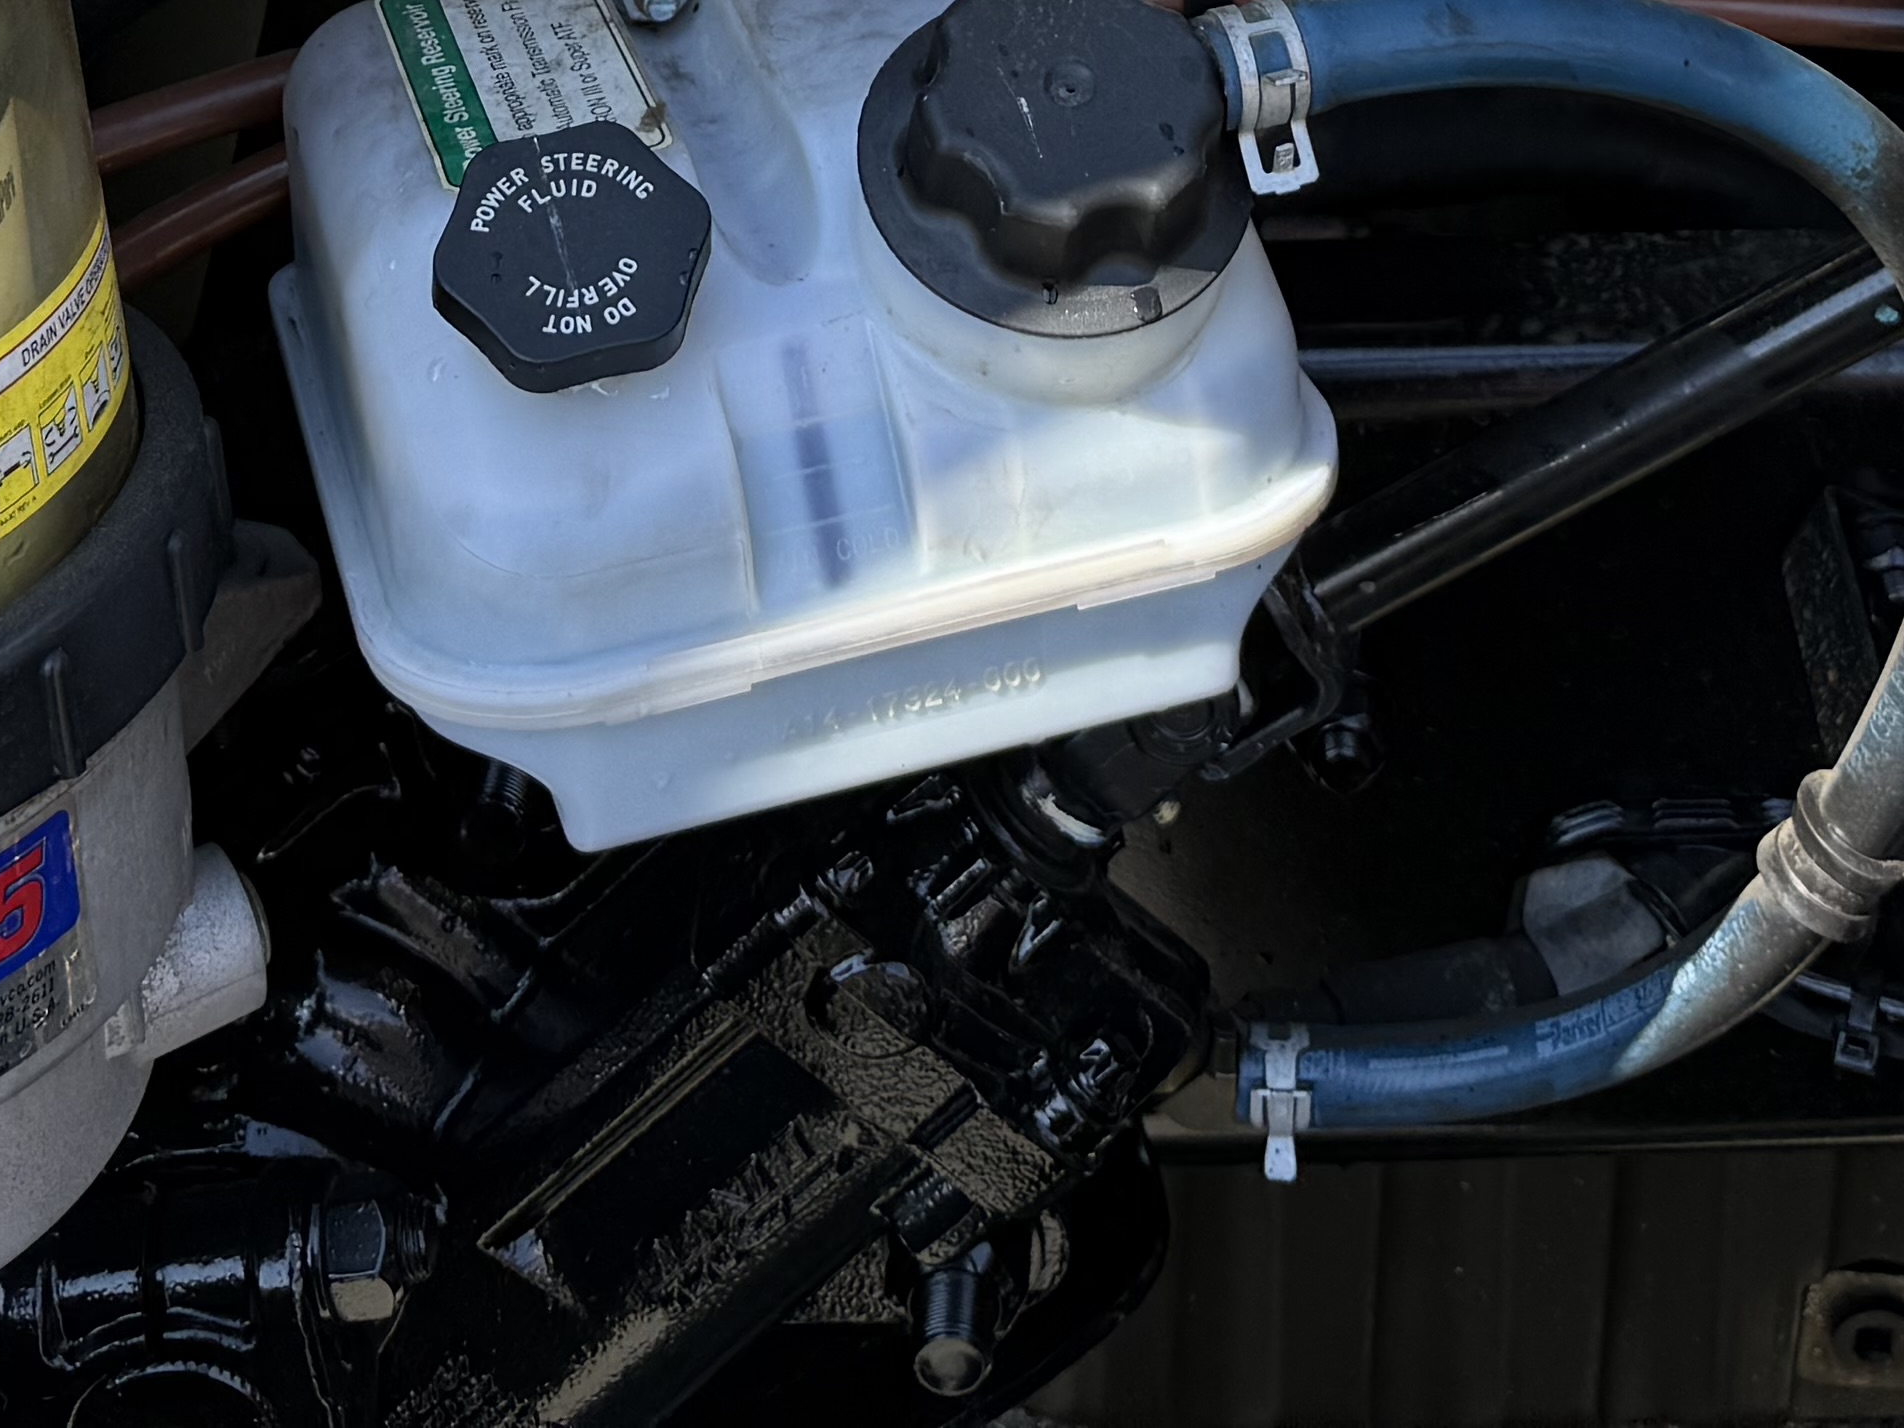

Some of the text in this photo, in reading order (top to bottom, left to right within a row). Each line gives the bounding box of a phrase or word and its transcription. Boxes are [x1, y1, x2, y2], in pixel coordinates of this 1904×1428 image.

[406, 3, 444, 66] Reservoir
[480, 30, 495, 45] on
[509, 10, 551, 78] Transmission
[569, 36, 591, 72] Super
[480, 44, 504, 71] mark
[582, 71, 597, 84] or
[432, 65, 469, 124] Steering
[496, 70, 533, 131] appropriate
[470, 153, 654, 232] POWER STEERING
[518, 179, 596, 213] FLUID
[525, 258, 638, 308] OVERFILL
[21, 326, 57, 368] DRAIN
[57, 289, 86, 337] VALVE
[543, 298, 637, 333] DO NOT
[14, 996, 60, 1035] U.S.A.
